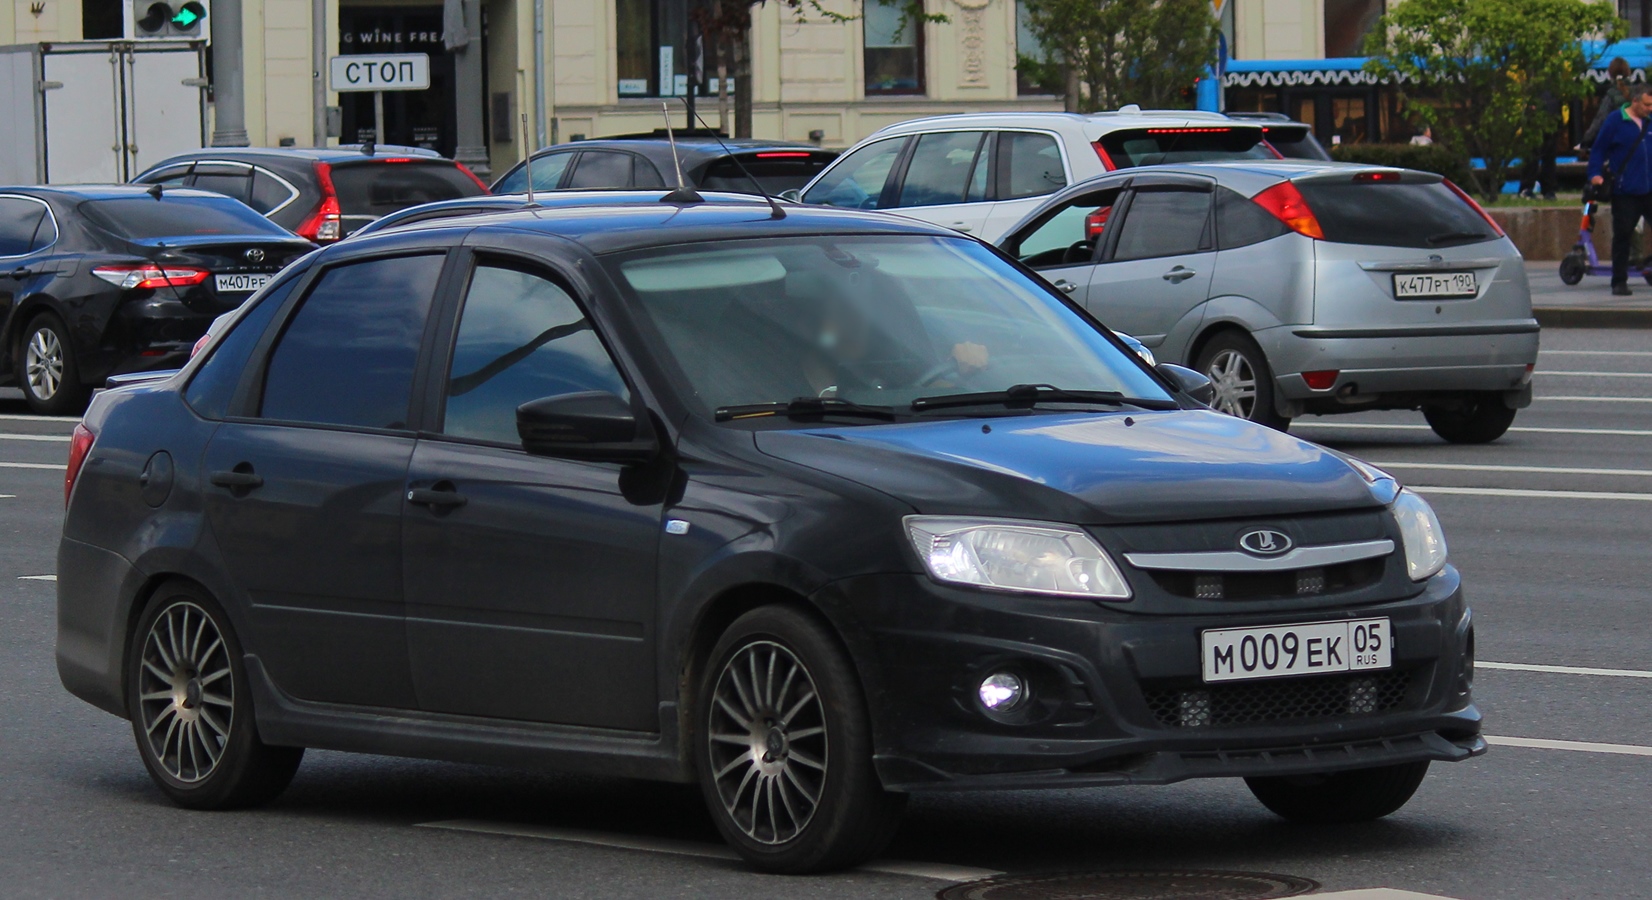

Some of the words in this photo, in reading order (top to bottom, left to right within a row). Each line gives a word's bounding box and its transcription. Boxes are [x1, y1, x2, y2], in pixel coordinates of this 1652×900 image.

[345, 61, 414, 84] СТОП
[1453, 274, 1472, 287] 190
[1354, 623, 1382, 652] 05
[1357, 654, 1378, 666] RUS
